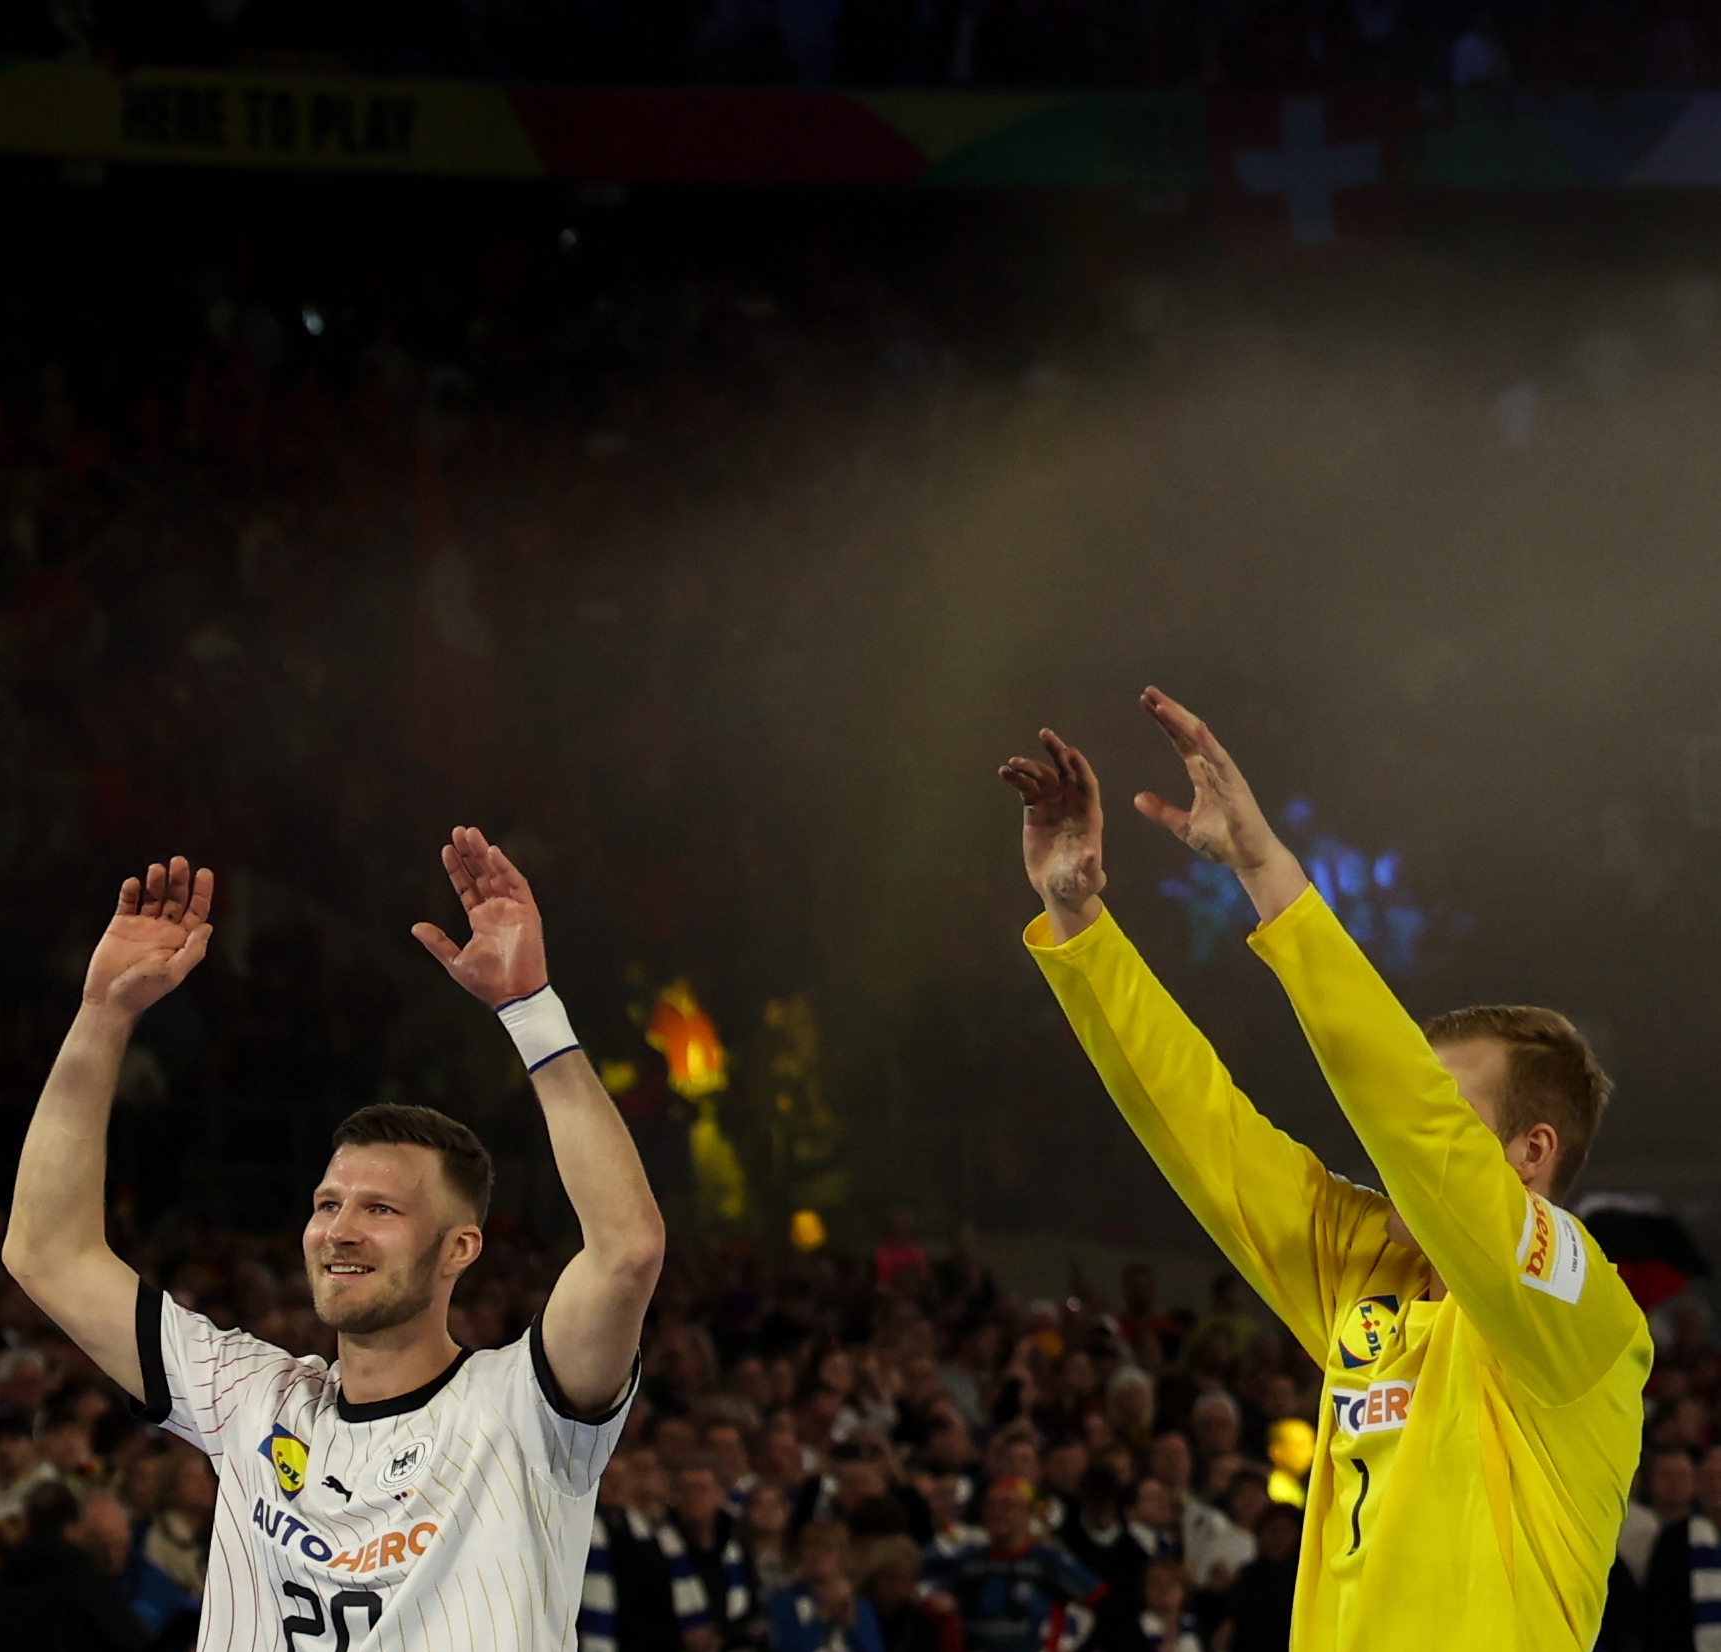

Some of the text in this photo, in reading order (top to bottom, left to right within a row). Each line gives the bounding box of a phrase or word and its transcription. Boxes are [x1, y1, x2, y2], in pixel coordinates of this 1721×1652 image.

[122, 84, 416, 151] HERE TO PLAY
[252, 1497, 439, 1574] AUTOHERO
